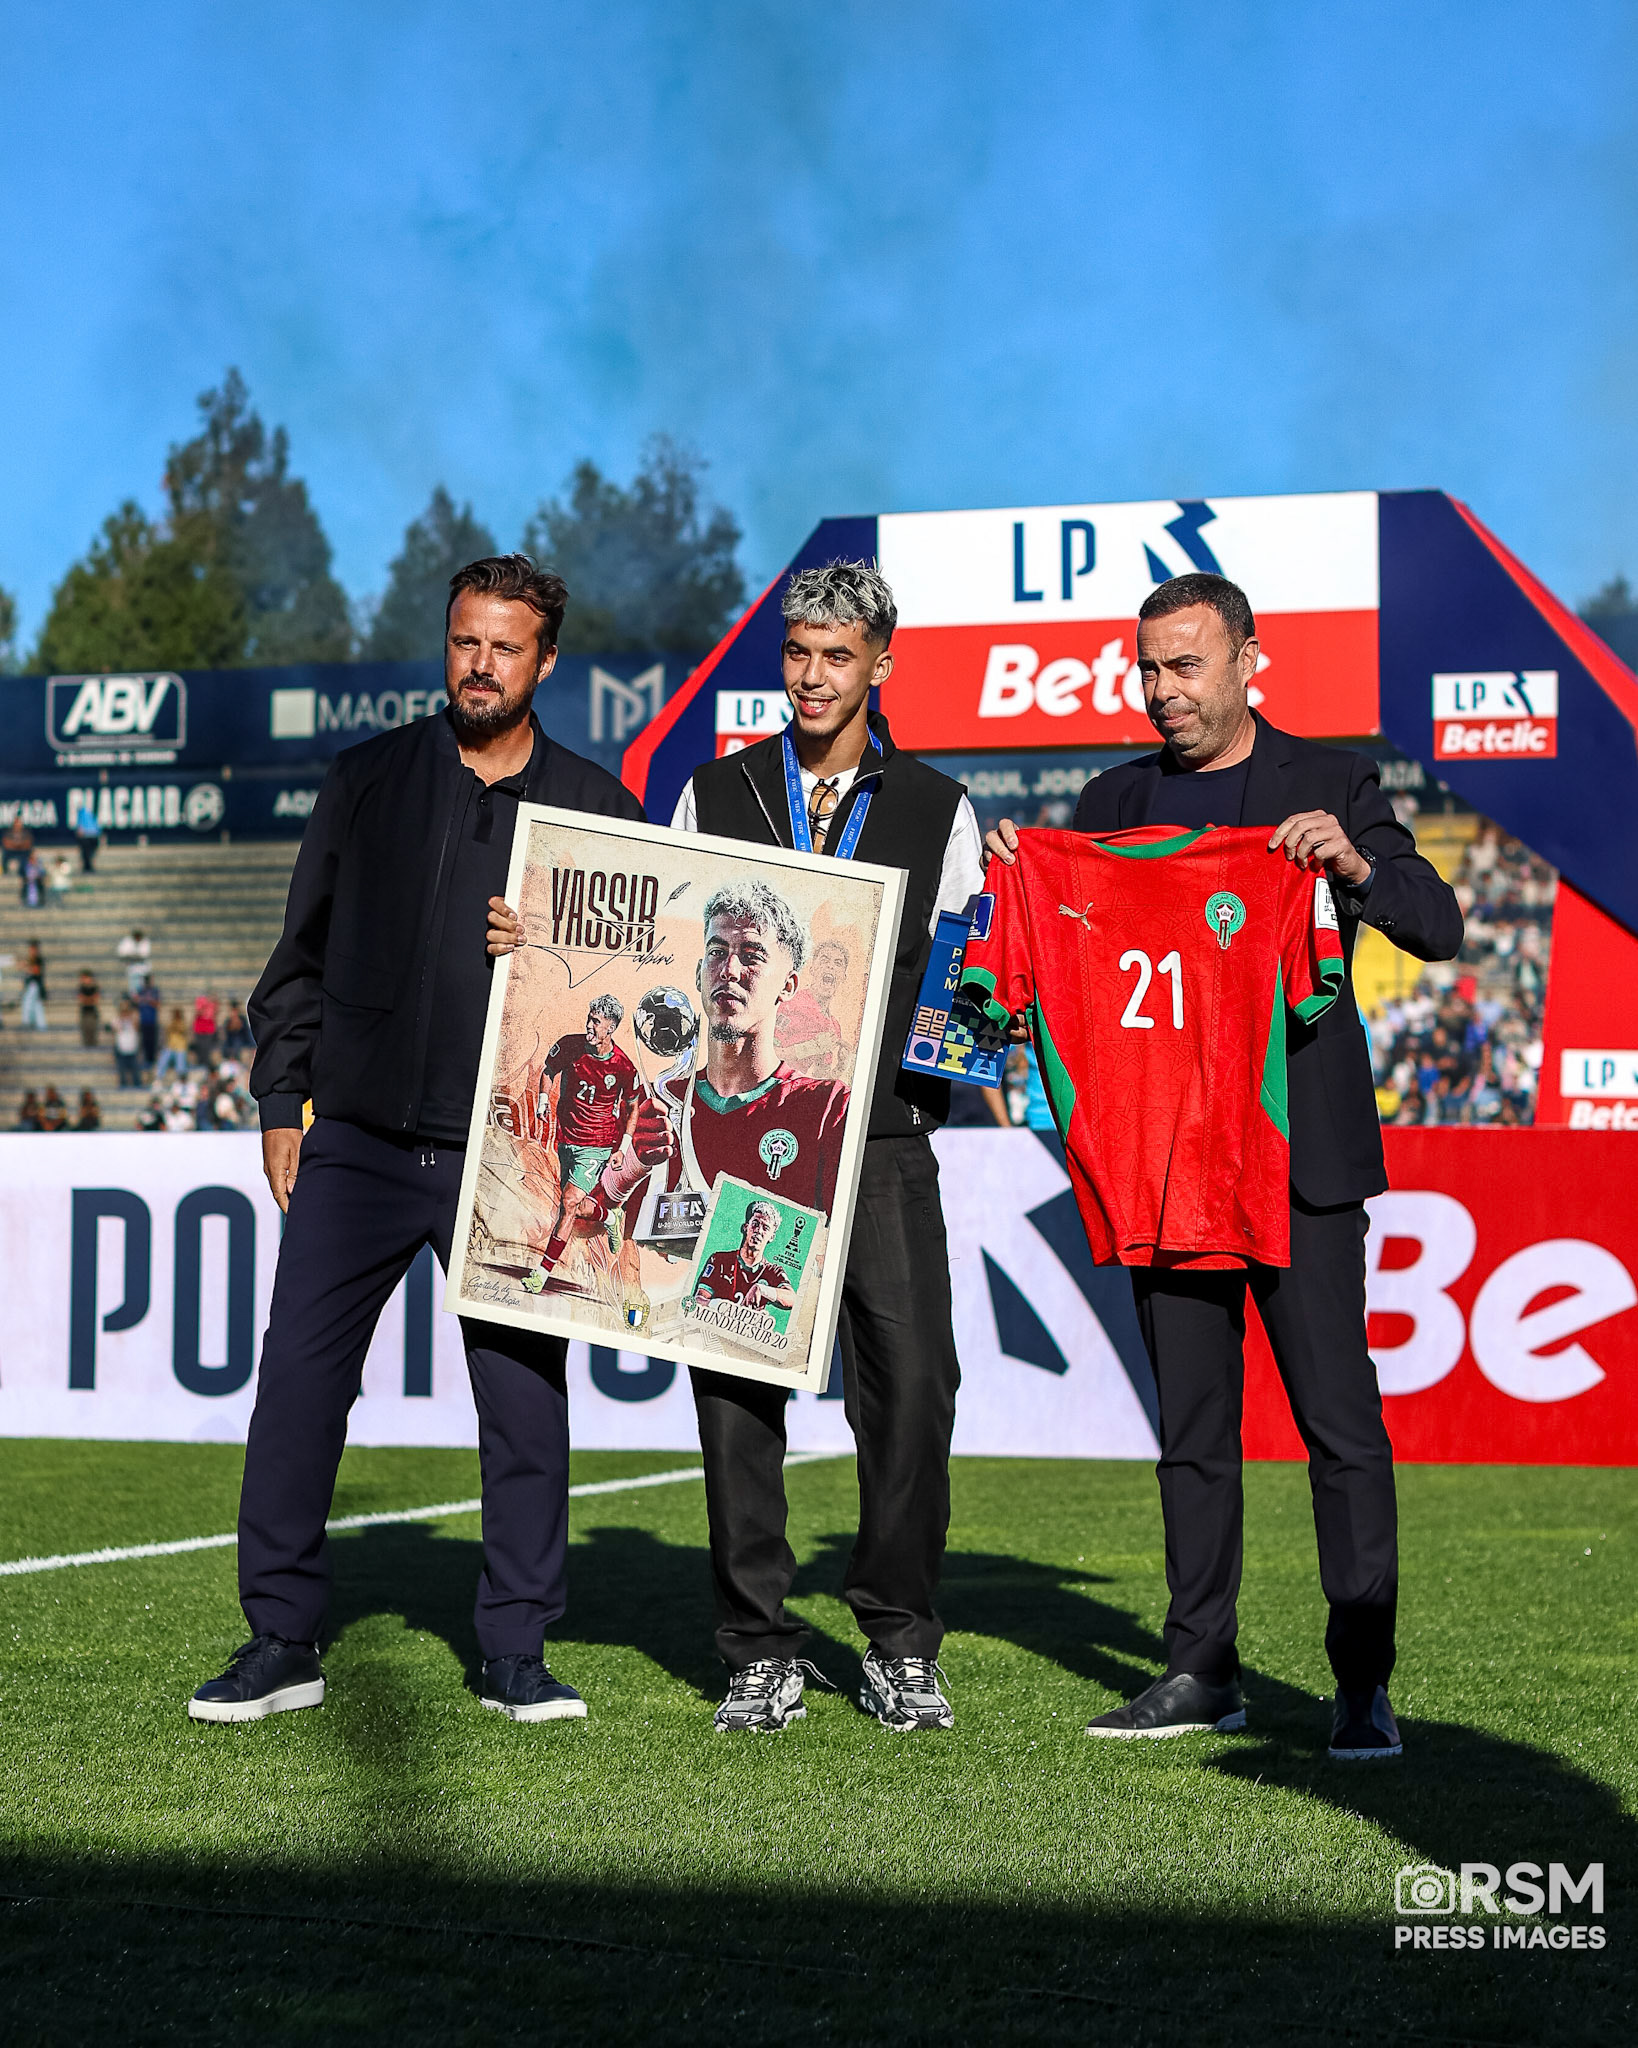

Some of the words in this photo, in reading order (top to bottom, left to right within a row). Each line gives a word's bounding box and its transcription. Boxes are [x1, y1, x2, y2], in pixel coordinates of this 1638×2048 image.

[1013, 519, 1096, 602] LP
[62, 676, 170, 735] ABV
[1455, 680, 1486, 711] LP
[1441, 720, 1548, 754] Betclic
[552, 867, 659, 953] YASSIR
[1119, 949, 1184, 1030] 21
[659, 1201, 704, 1219] FIFA
[717, 1301, 774, 1331] CAMPEÃO
[771, 1334, 788, 1350] 20
